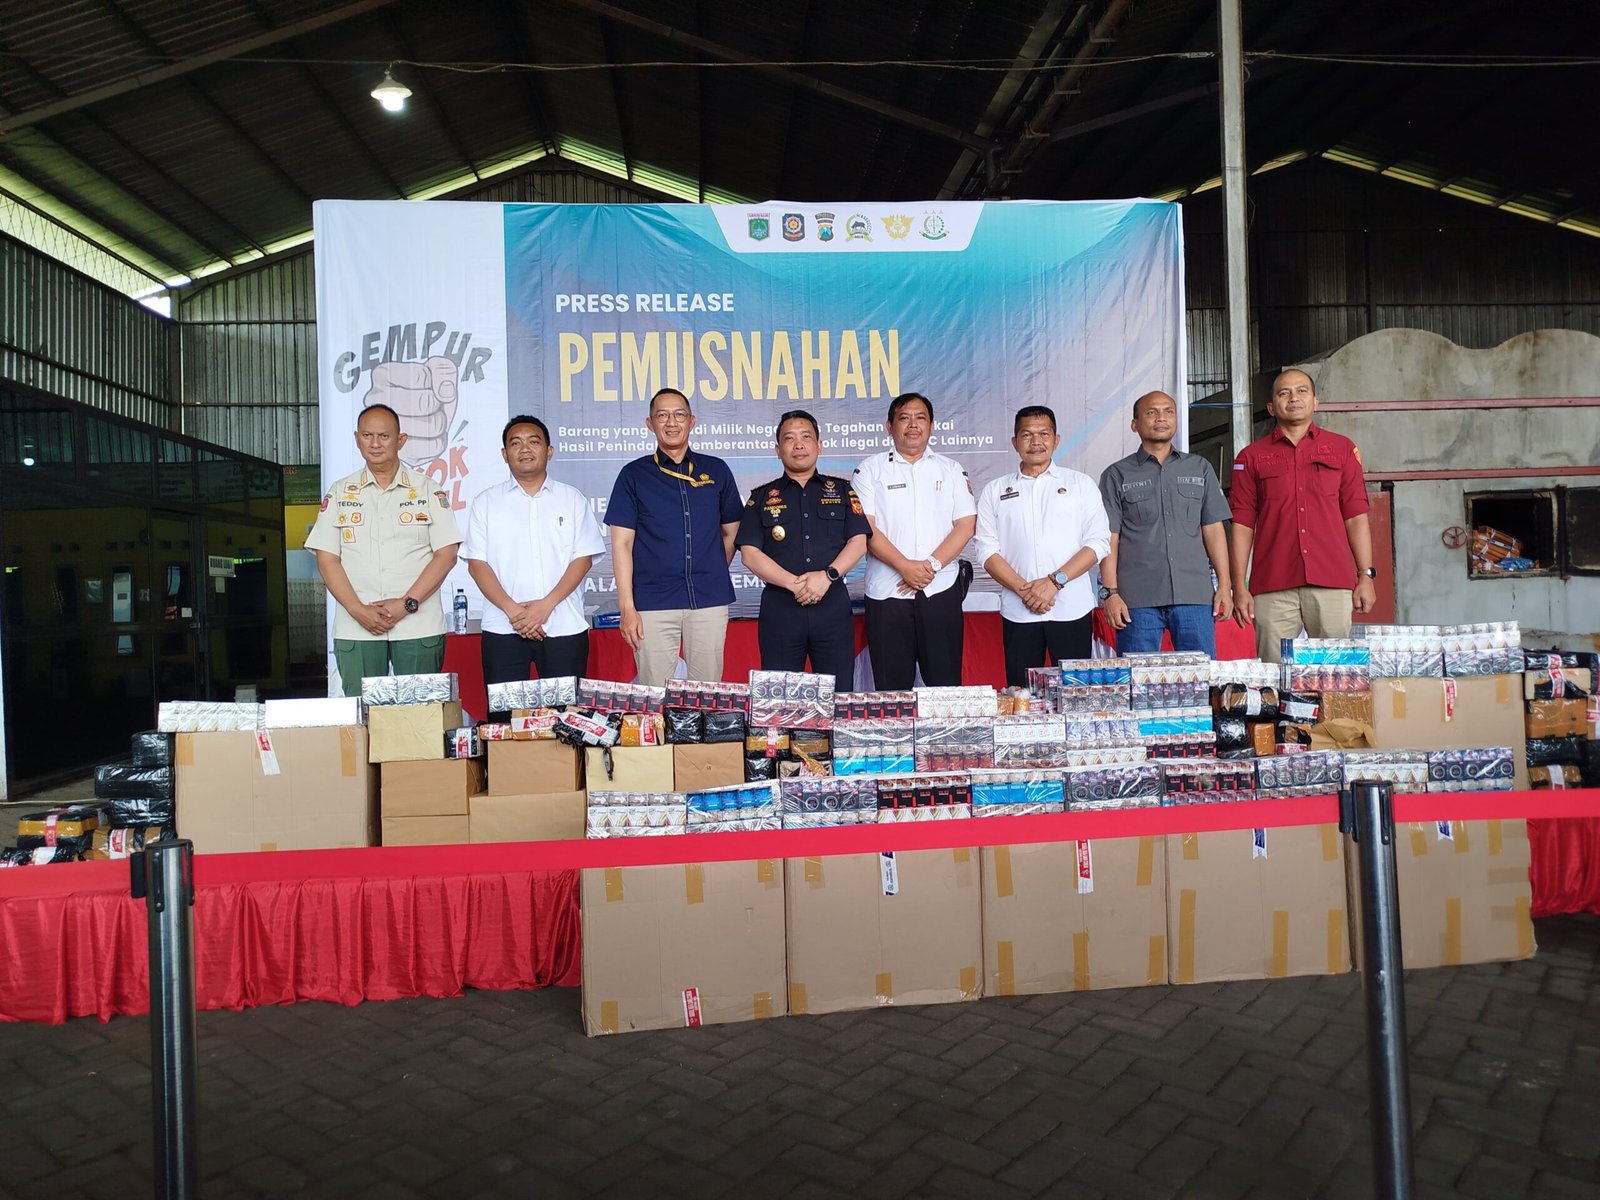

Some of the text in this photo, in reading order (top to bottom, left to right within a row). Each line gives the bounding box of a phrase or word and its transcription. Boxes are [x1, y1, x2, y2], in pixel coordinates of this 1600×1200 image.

[555, 293, 735, 313] PRESS RELEASE
[333, 320, 494, 394] GEMPUR
[558, 328, 901, 403] PEMUSNAHAN
[558, 426, 609, 439] Barang
[613, 427, 648, 439] yang
[711, 423, 744, 435] Milik
[825, 422, 884, 435] Tegahan
[934, 419, 954, 431] kai
[559, 441, 594, 452] Hasil
[688, 440, 778, 451] emberantas
[841, 436, 879, 449] Ilegal
[941, 434, 994, 447] Lainnya
